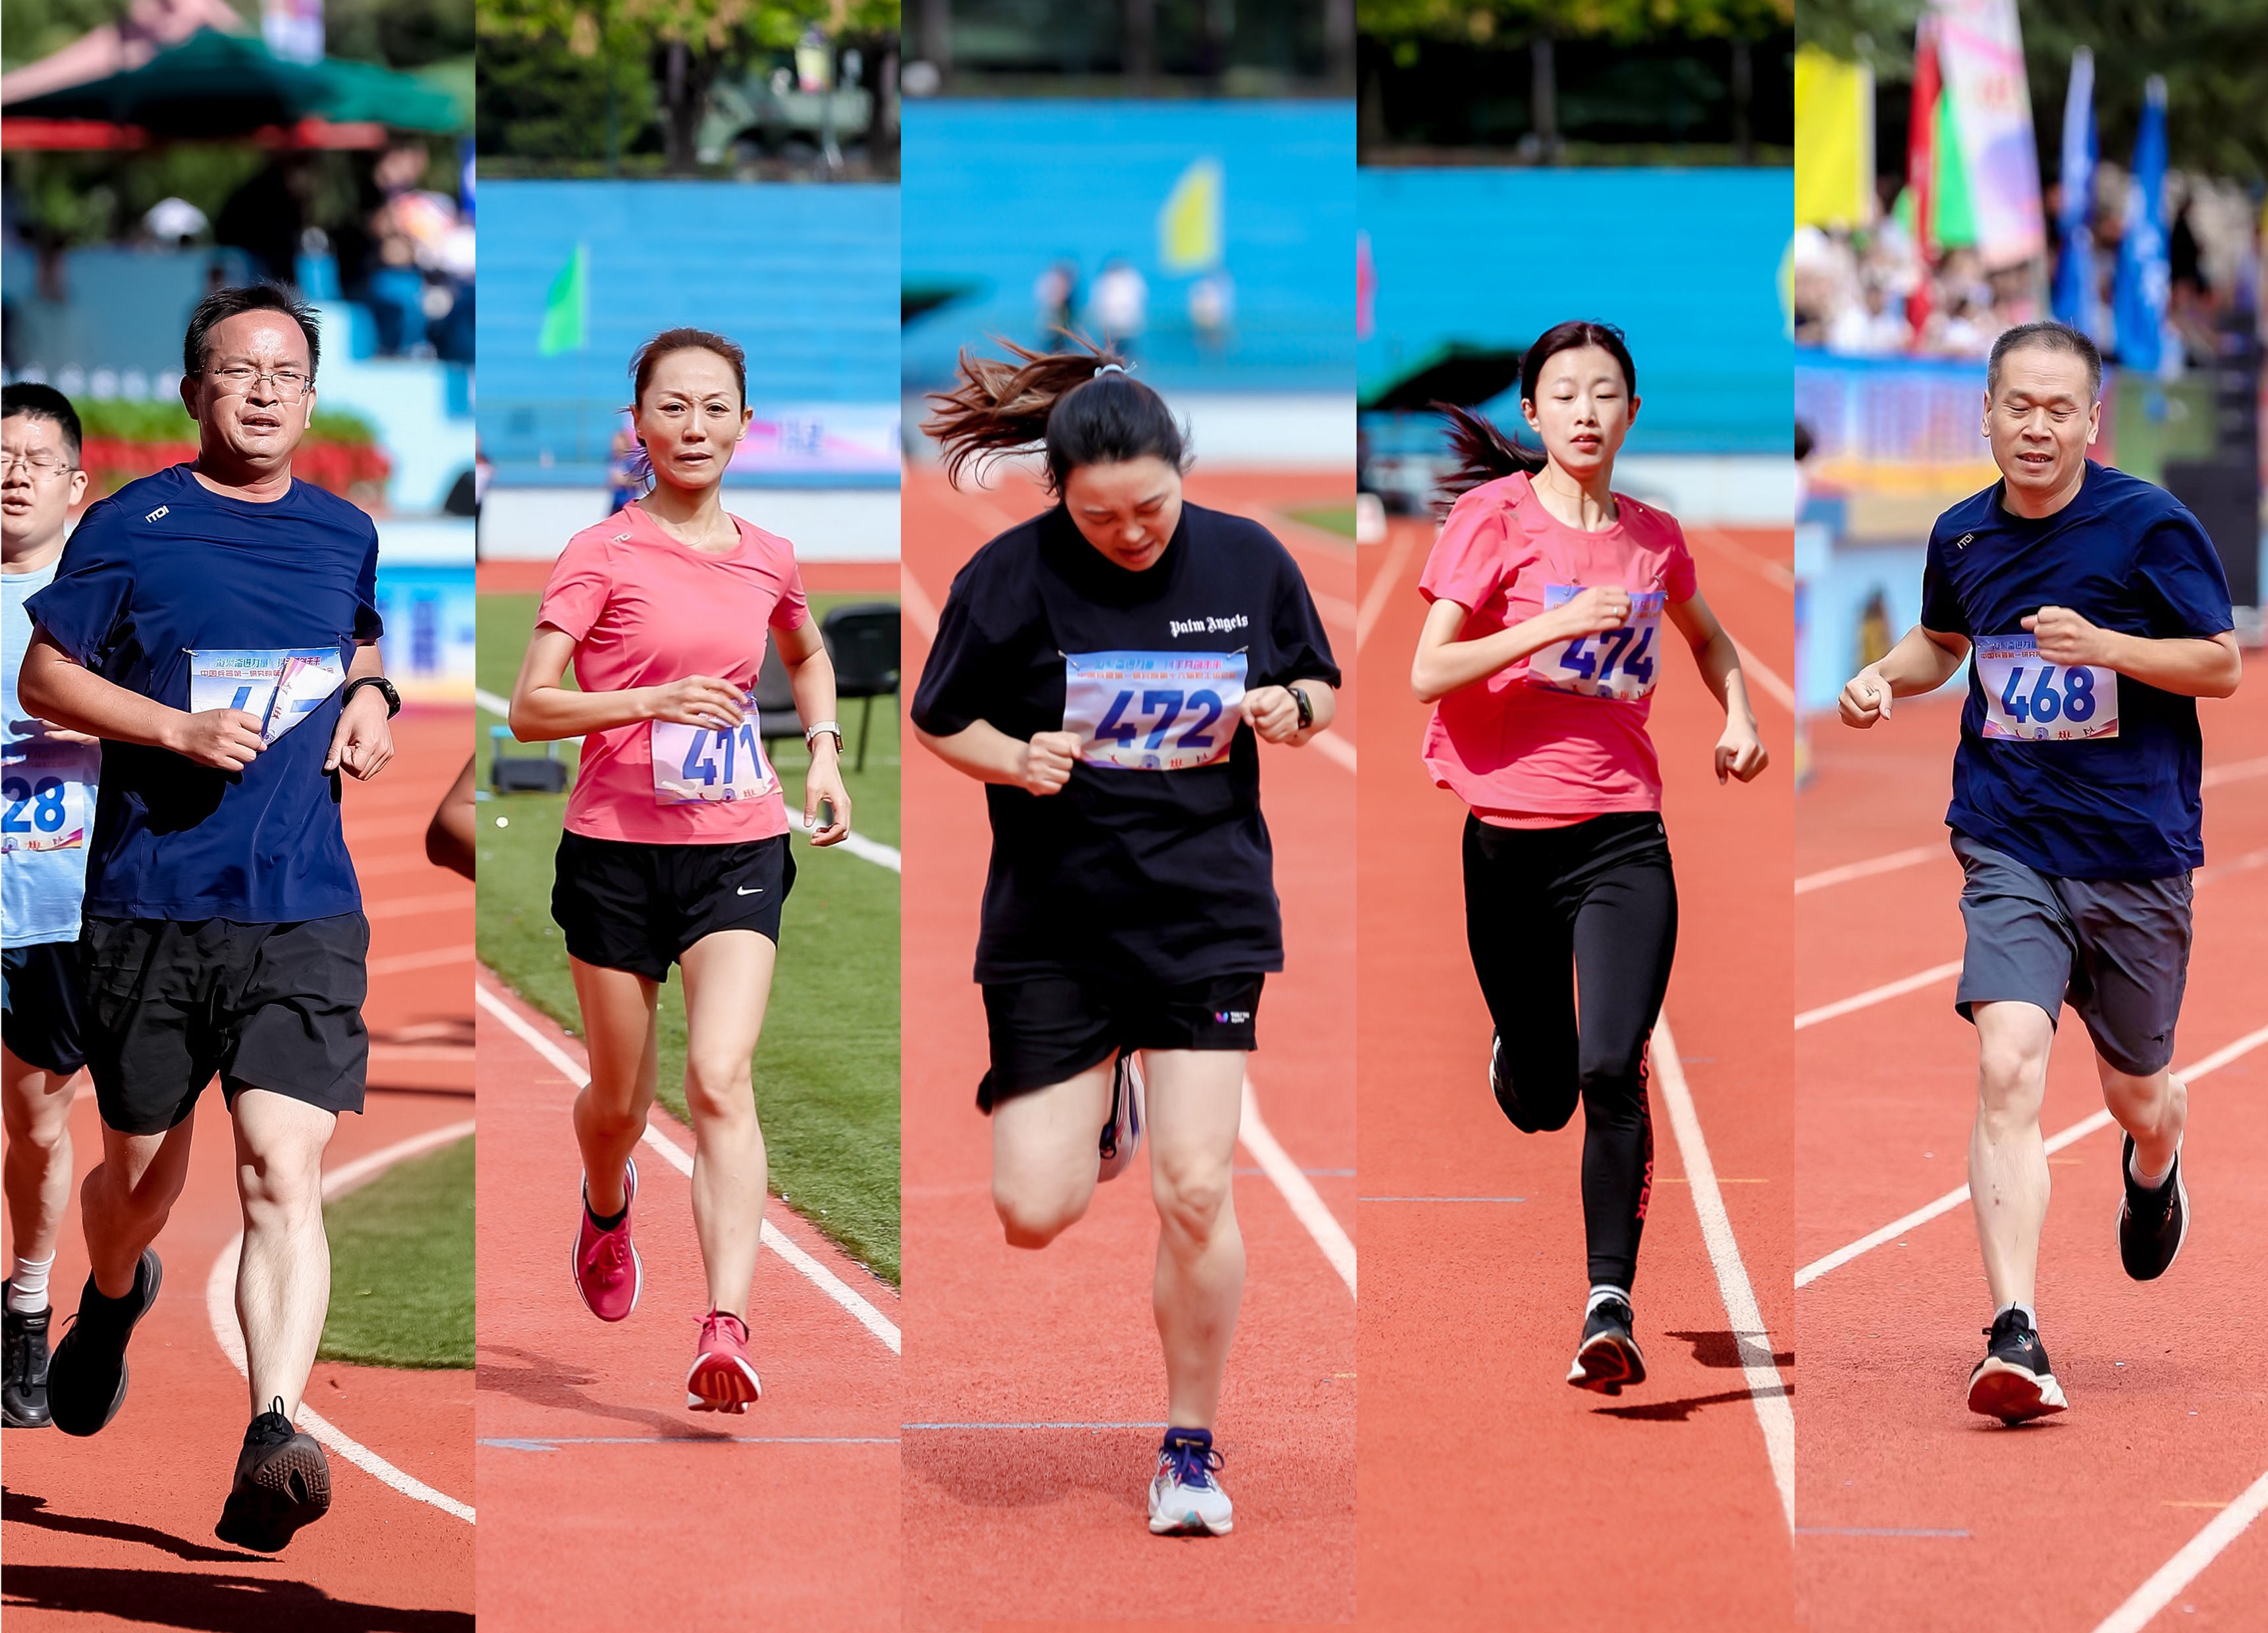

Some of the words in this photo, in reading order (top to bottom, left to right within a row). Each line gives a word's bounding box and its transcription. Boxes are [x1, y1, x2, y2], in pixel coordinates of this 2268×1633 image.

[1170, 618, 1206, 638] Palm
[1206, 613, 1249, 633] Angels
[1560, 627, 1654, 684] 474
[1094, 689, 1223, 749] 472
[2001, 666, 2095, 724] 468
[682, 724, 763, 786] 471
[1, 776, 66, 833] 28
